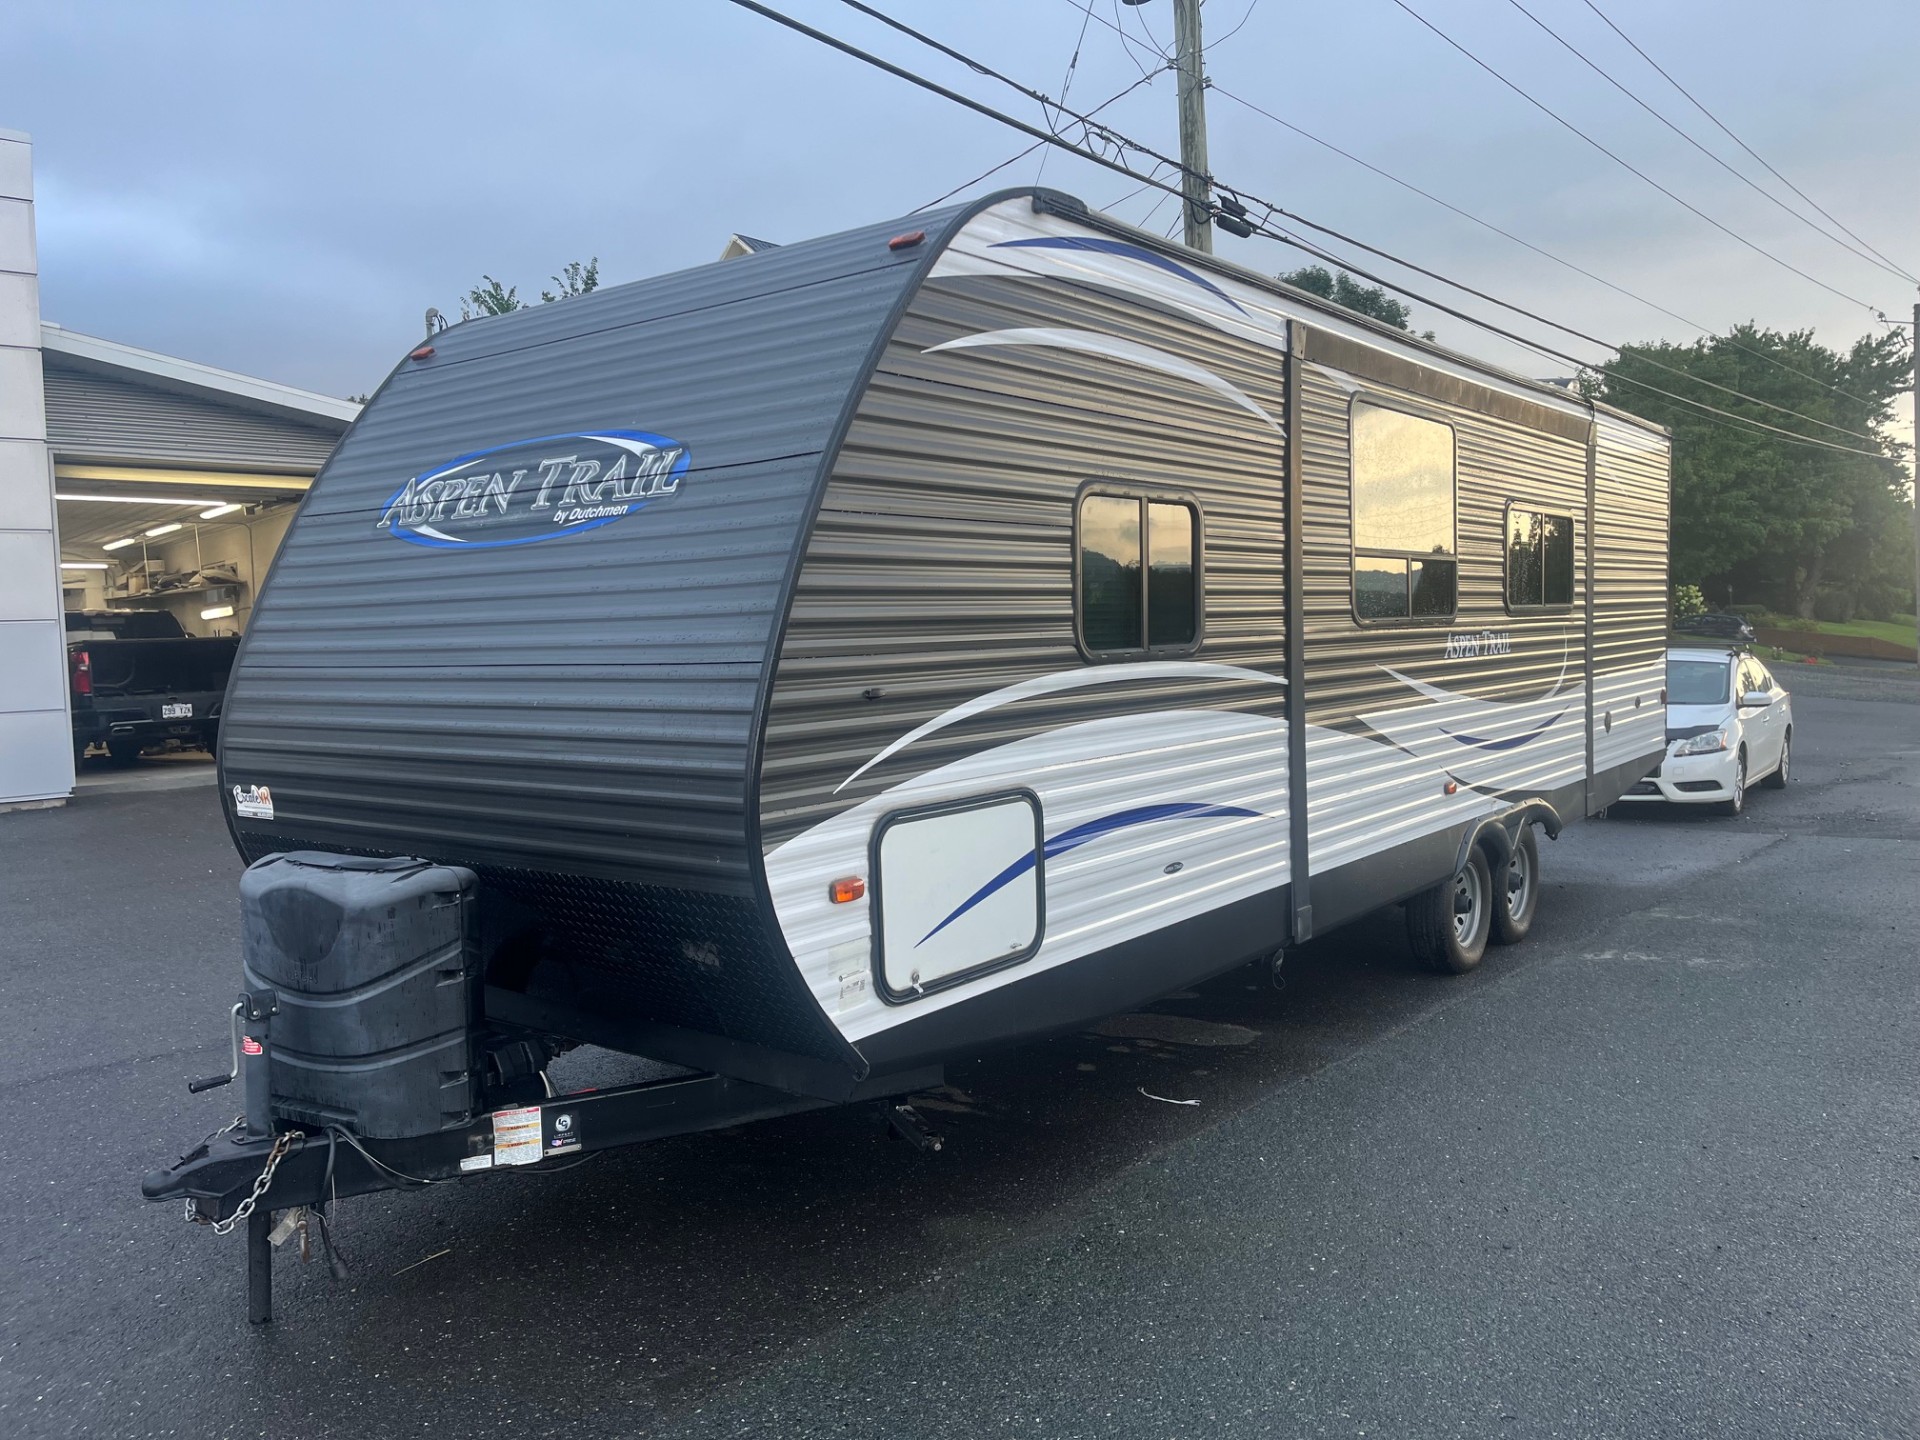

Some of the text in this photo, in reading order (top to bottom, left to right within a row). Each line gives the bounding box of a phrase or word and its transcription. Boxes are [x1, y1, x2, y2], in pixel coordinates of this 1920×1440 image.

[377, 448, 682, 528] ASPEN TRAIL
[553, 505, 628, 524] by Dutchmen
[1444, 630, 1511, 658] ASPEN TRAIL
